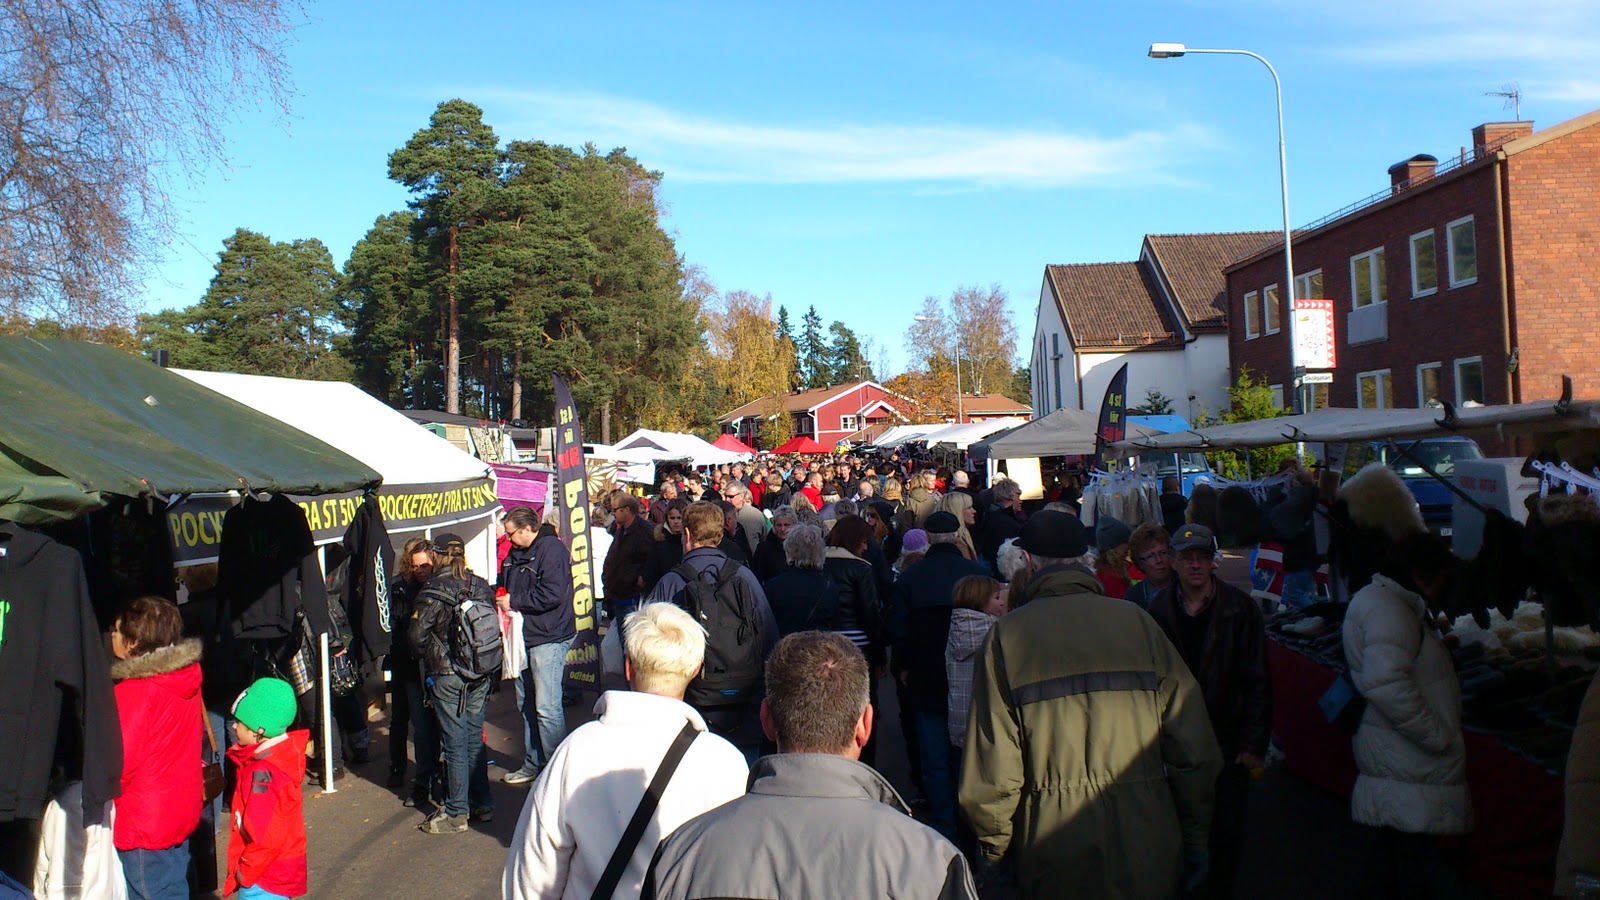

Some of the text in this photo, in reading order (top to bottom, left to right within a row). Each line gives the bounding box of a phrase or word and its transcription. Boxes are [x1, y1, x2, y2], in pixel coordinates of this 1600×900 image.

[322, 498, 338, 530] ST
[338, 498, 357, 527] 50
[441, 487, 463, 515] FYRA
[462, 487, 473, 511] ST
[471, 485, 487, 509] 50
